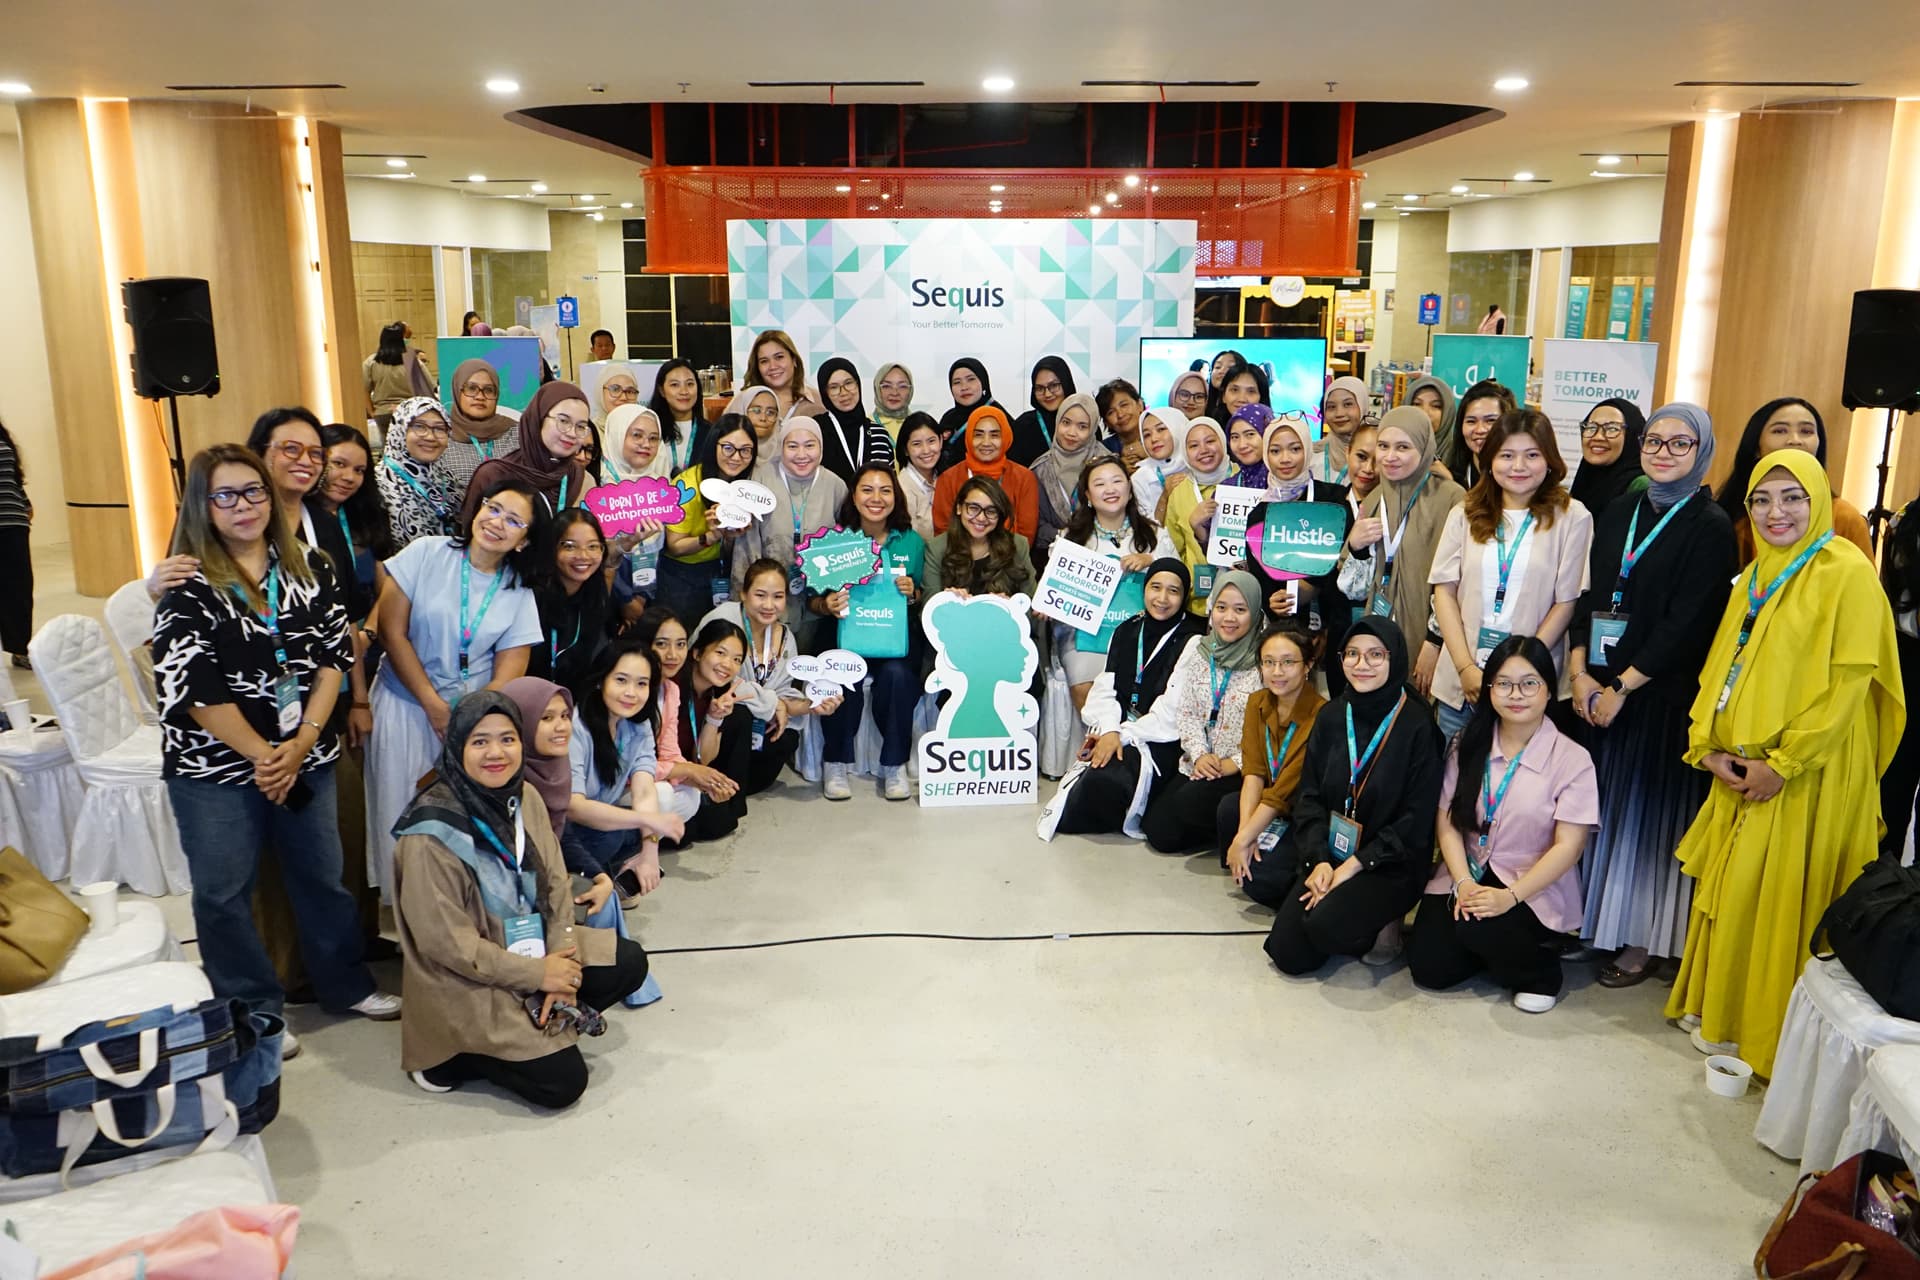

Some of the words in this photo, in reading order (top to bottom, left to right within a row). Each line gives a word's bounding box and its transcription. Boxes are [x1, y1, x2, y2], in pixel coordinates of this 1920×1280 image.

[912, 279, 1004, 314] Sequis
[912, 320, 931, 329] Your
[933, 320, 958, 329] Better
[960, 320, 1004, 329] Tomorrow
[1554, 370, 1608, 384] BETTER
[1554, 384, 1640, 401] TOMORROW
[609, 495, 632, 511] BORN
[646, 491, 659, 505] BE
[736, 487, 773, 506] Sequis
[597, 504, 675, 523] Youthpreneur
[1222, 503, 1256, 517] BET
[1222, 517, 1247, 526] TOMO
[1270, 525, 1337, 547] Hustle
[828, 547, 866, 566] Sequis
[1218, 539, 1246, 561] Seq
[1057, 556, 1113, 587] BETTER
[1090, 558, 1117, 575] YOUR
[1055, 568, 1108, 595] TOMORROW
[856, 606, 894, 620] Sequis
[1044, 589, 1094, 622] Sequis
[791, 661, 819, 673] Sequis
[825, 658, 862, 673] Sequis
[811, 686, 839, 697] Sequis
[925, 740, 1032, 780] Sequis
[924, 780, 1032, 797] SHEPRENEUR
